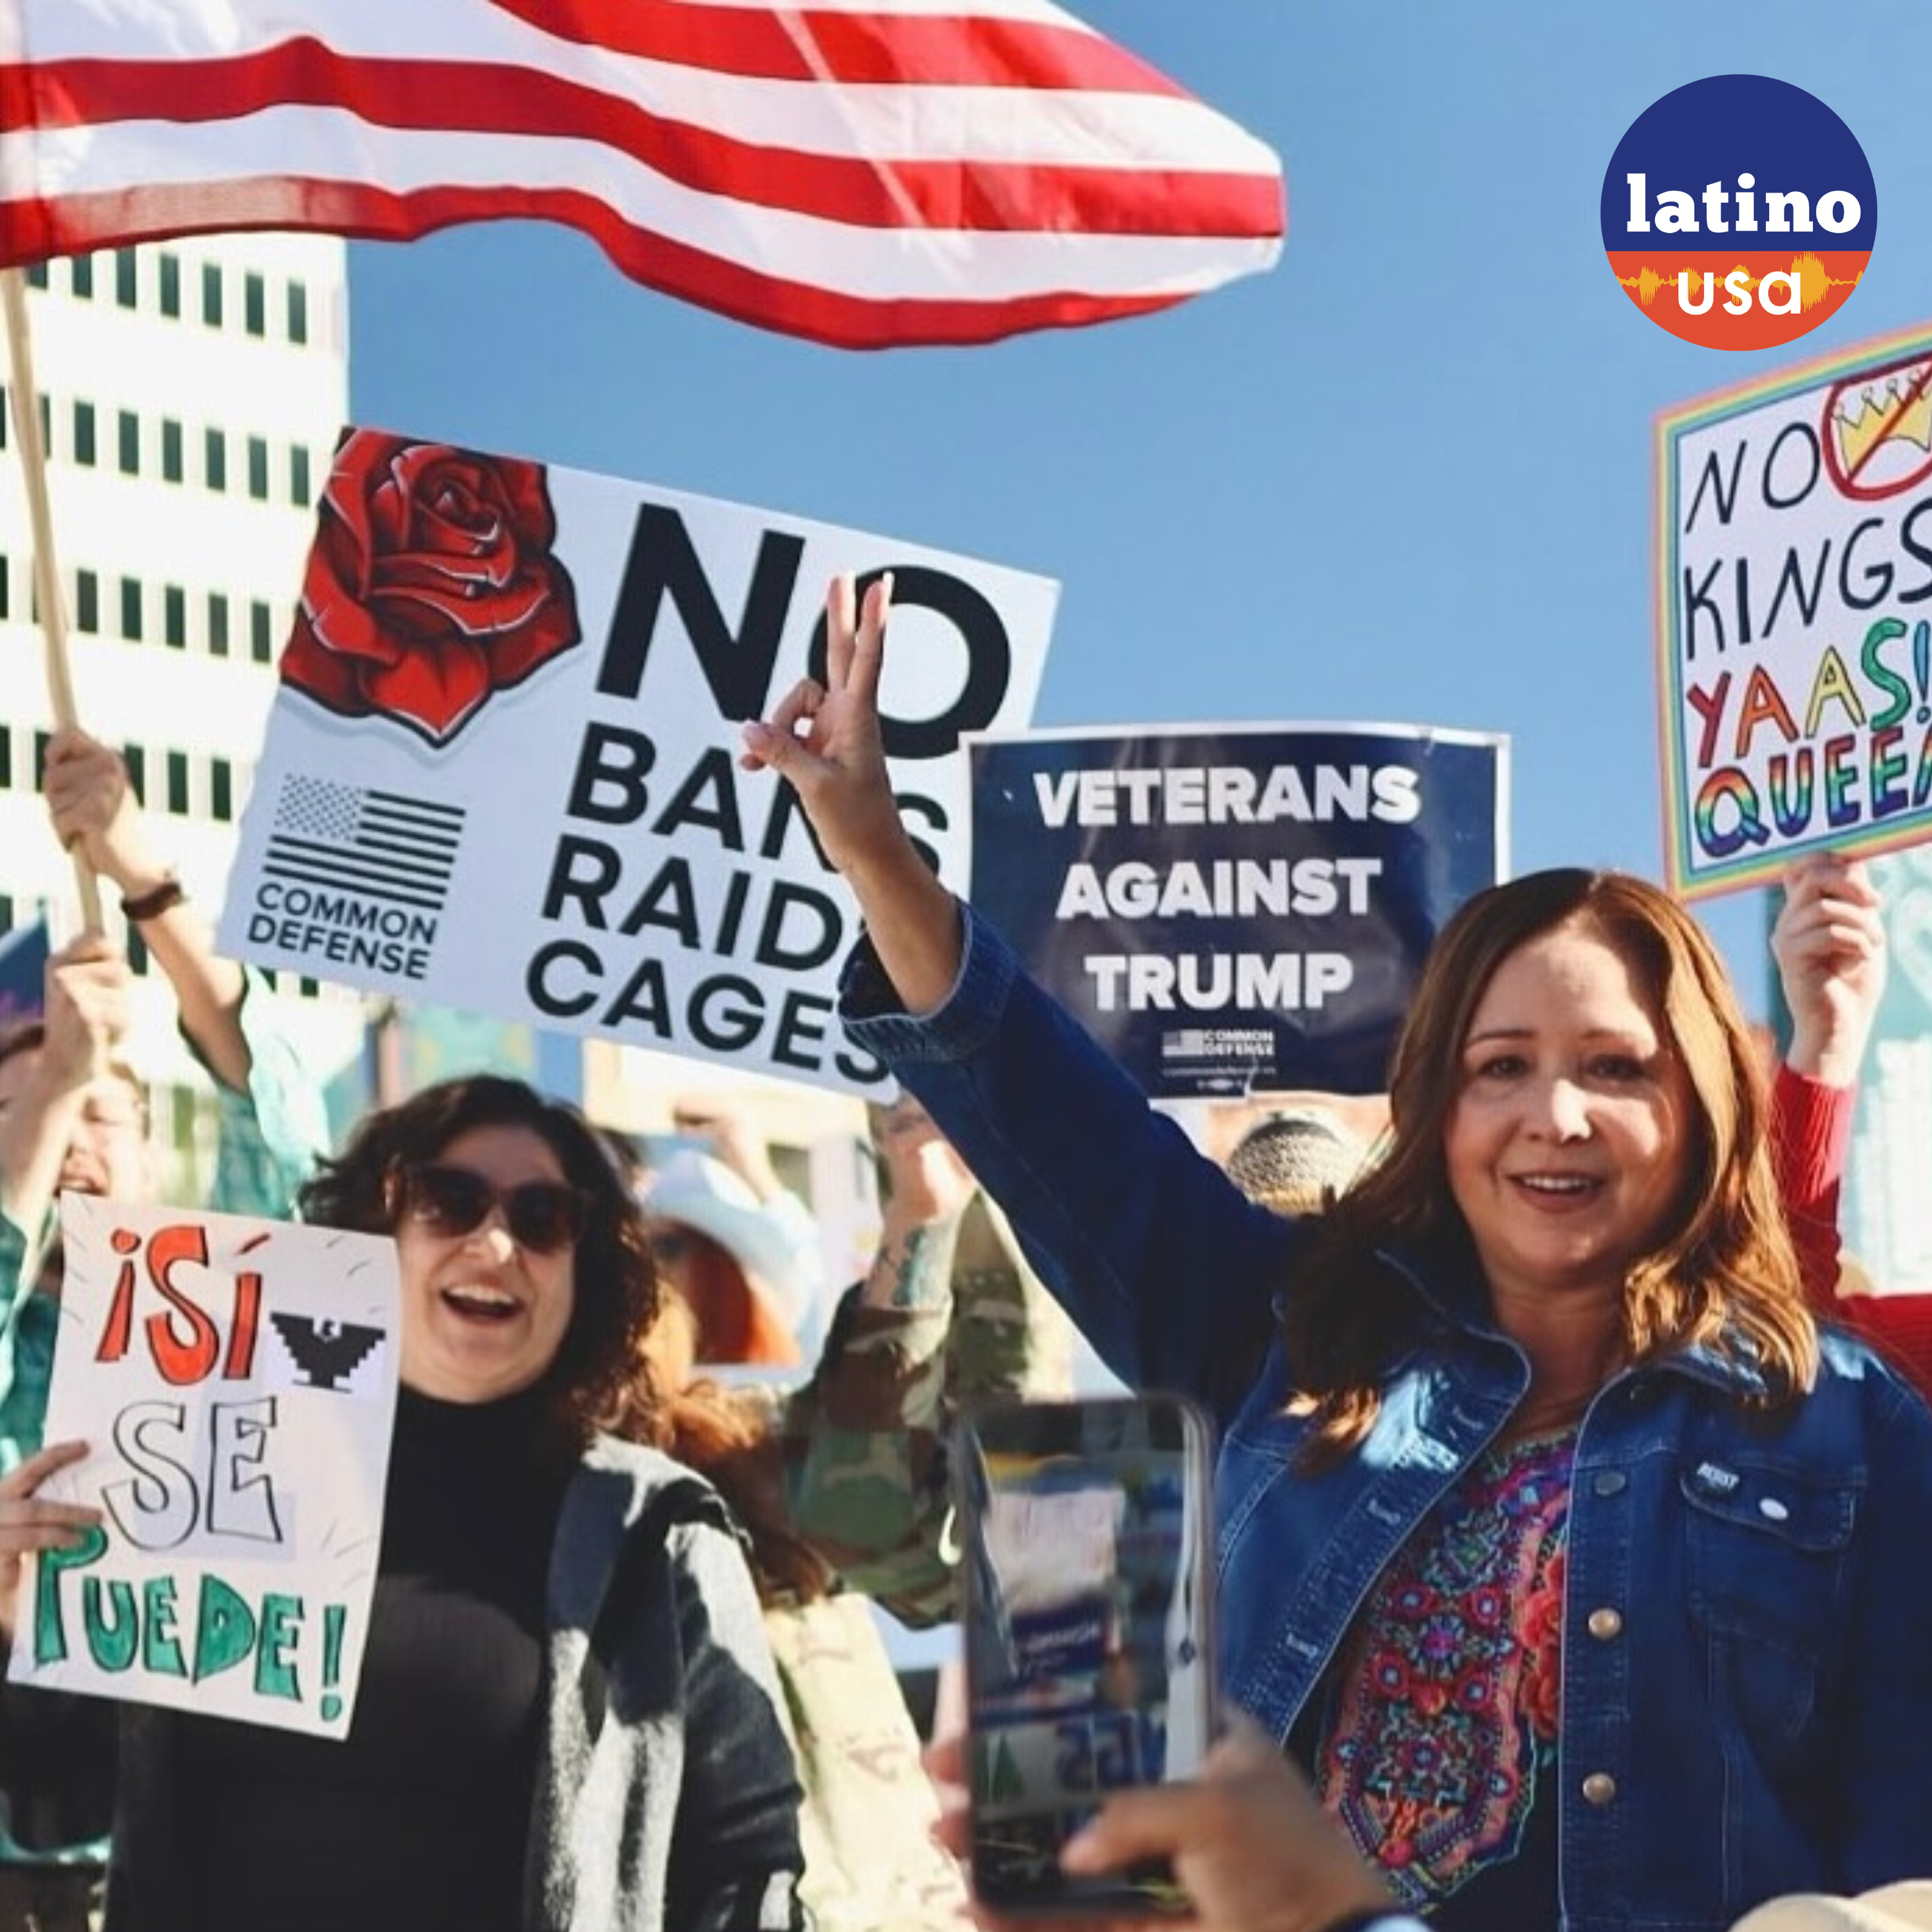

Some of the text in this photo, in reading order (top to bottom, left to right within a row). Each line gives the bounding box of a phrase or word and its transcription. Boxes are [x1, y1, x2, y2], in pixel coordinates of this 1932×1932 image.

[1685, 421, 1821, 533] NO
[594, 502, 1011, 760] NO
[1684, 497, 1932, 661] KINGS
[1686, 616, 1931, 768] YAAS!
[1033, 764, 1421, 827] VETERANS
[247, 914, 432, 980] DEFENSE
[255, 882, 438, 945] COMMON
[541, 833, 866, 973] RAID
[1055, 858, 1383, 920] AGAINST
[526, 938, 890, 1085] CAGES
[1084, 953, 1354, 1012] TRUMP
[100, 1396, 283, 1550] SE
[34, 1523, 346, 1721] PUEDE!
